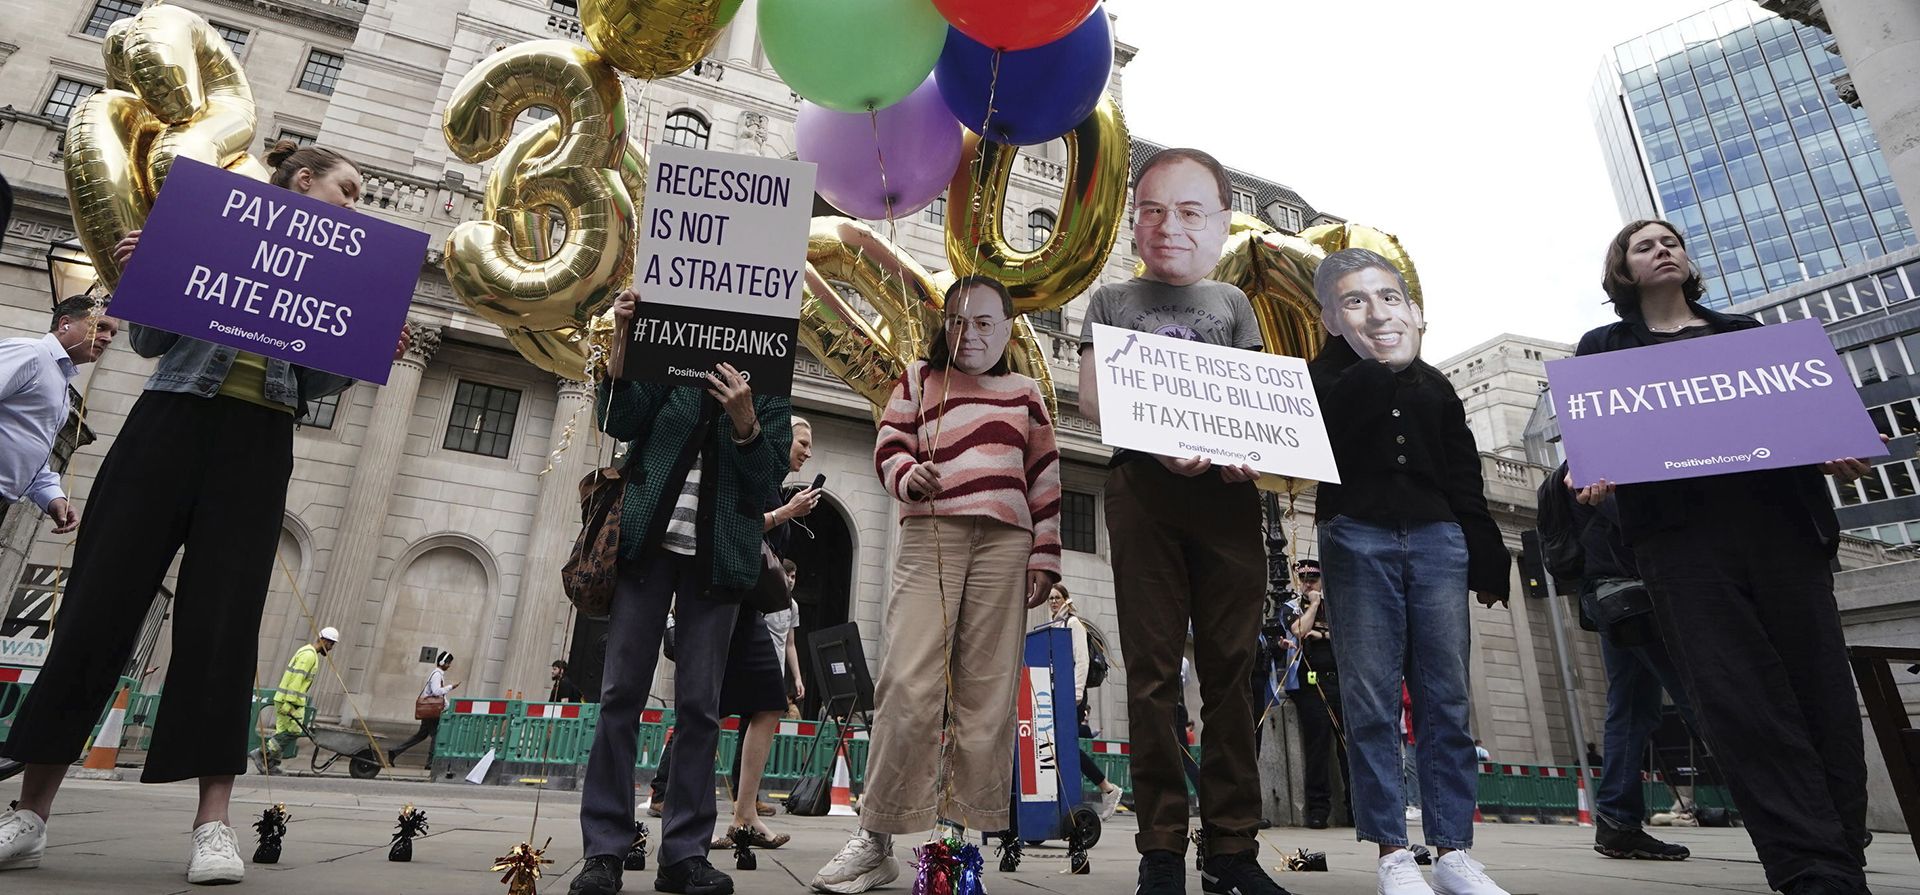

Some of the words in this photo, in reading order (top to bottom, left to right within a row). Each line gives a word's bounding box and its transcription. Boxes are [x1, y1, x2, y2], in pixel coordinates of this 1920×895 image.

[656, 162, 790, 208] RECESSION
[222, 189, 287, 231] PAY
[287, 209, 366, 257] RISES
[650, 208, 673, 240] IS
[679, 211, 729, 246] NOT
[252, 240, 314, 282] NOT
[644, 254, 661, 286] A
[669, 256, 799, 300] STRATEGY
[184, 265, 270, 315] RATE
[269, 288, 352, 337] RISES
[1132, 304, 1177, 330] CHANGE
[1184, 307, 1226, 333] MONEY
[209, 320, 289, 350] PositiveMoney
[633, 317, 788, 358] #TAXTHEBANKS
[1139, 345, 1191, 372] RATE
[1196, 355, 1252, 382] RISES
[1256, 365, 1305, 391] COST
[1108, 364, 1148, 391] THE
[1153, 373, 1223, 403] PUBLIC
[1226, 386, 1315, 418] BILLIONS
[1567, 358, 1834, 421] #TAXTHEBANKS
[1132, 400, 1300, 449] #TAXTHEBANKS
[1178, 441, 1248, 461] PositiveMoney
[1664, 451, 1753, 471] PositiveMoney
[0, 639, 45, 657] WAY
[1018, 720, 1030, 736] IG
